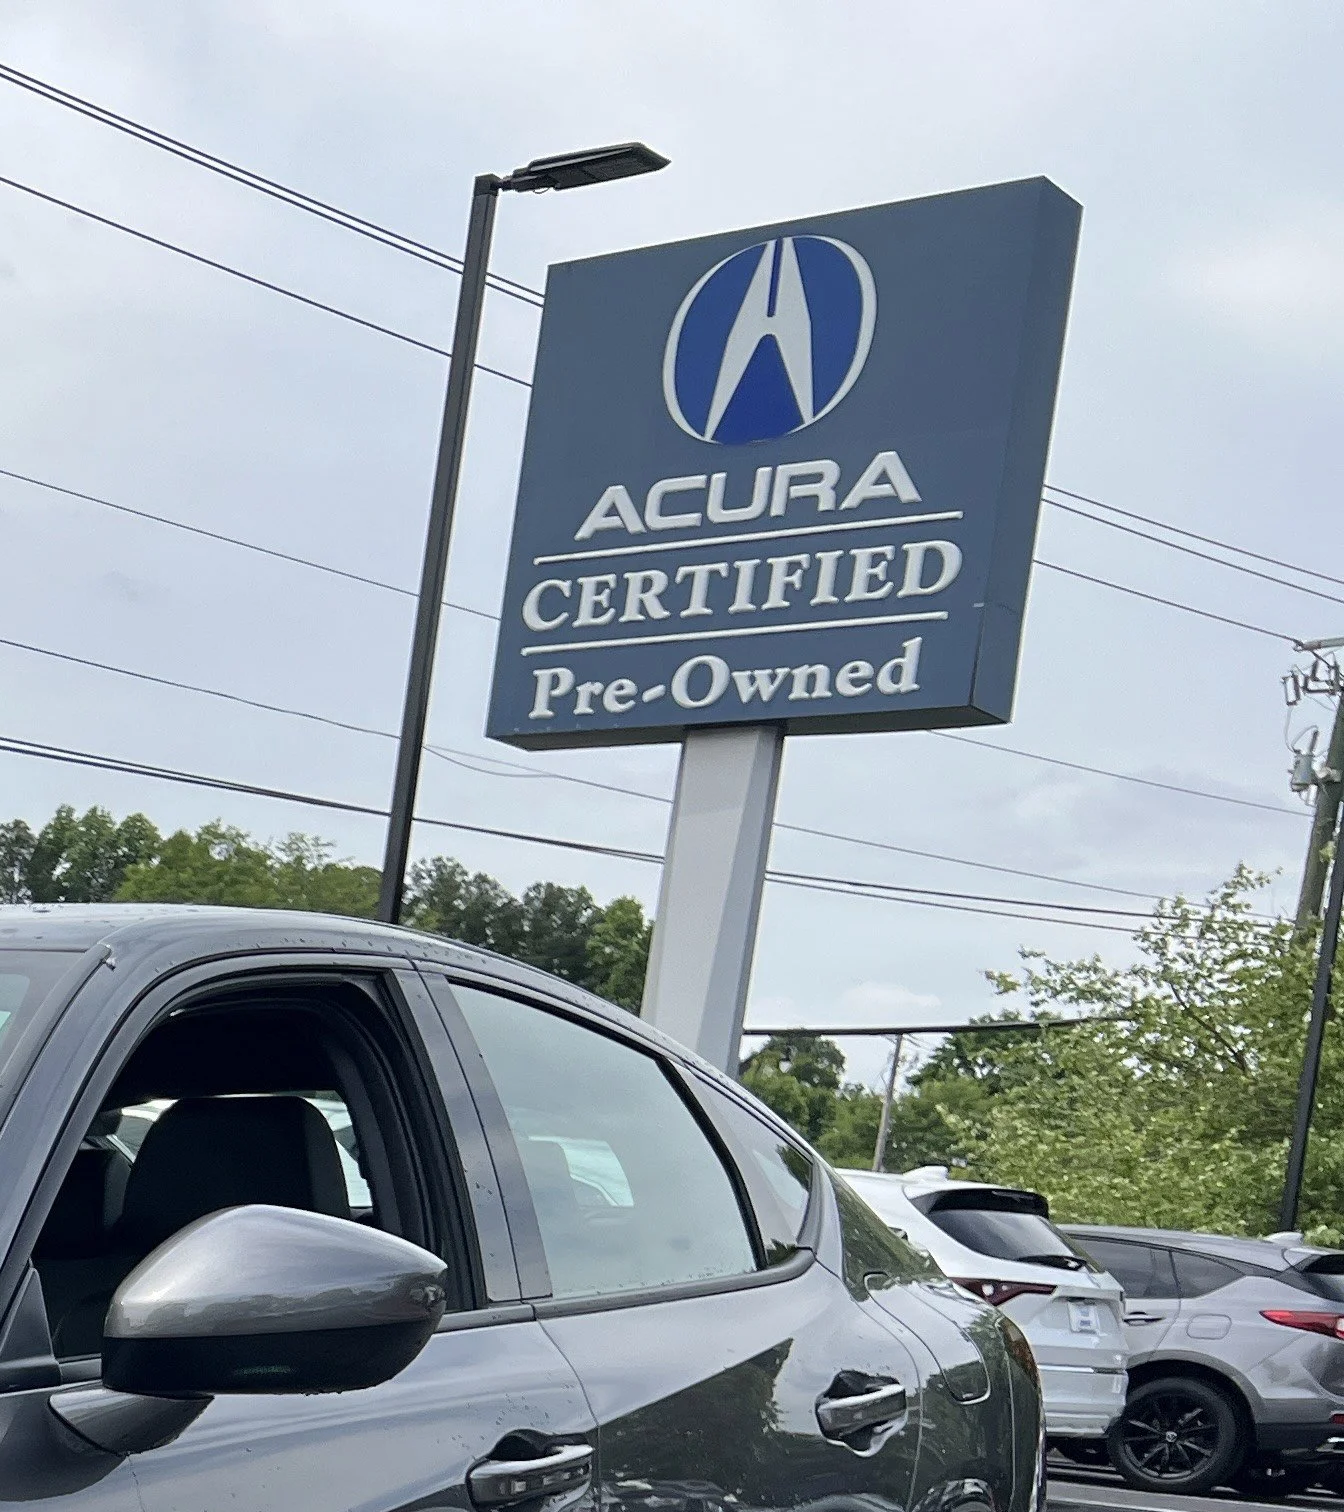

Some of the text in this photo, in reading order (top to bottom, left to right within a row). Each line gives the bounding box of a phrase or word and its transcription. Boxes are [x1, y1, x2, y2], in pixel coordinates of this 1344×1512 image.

[575, 450, 923, 541] ACURA
[521, 539, 964, 632] CERTIFIED
[528, 637, 923, 719] Pre-Owned
